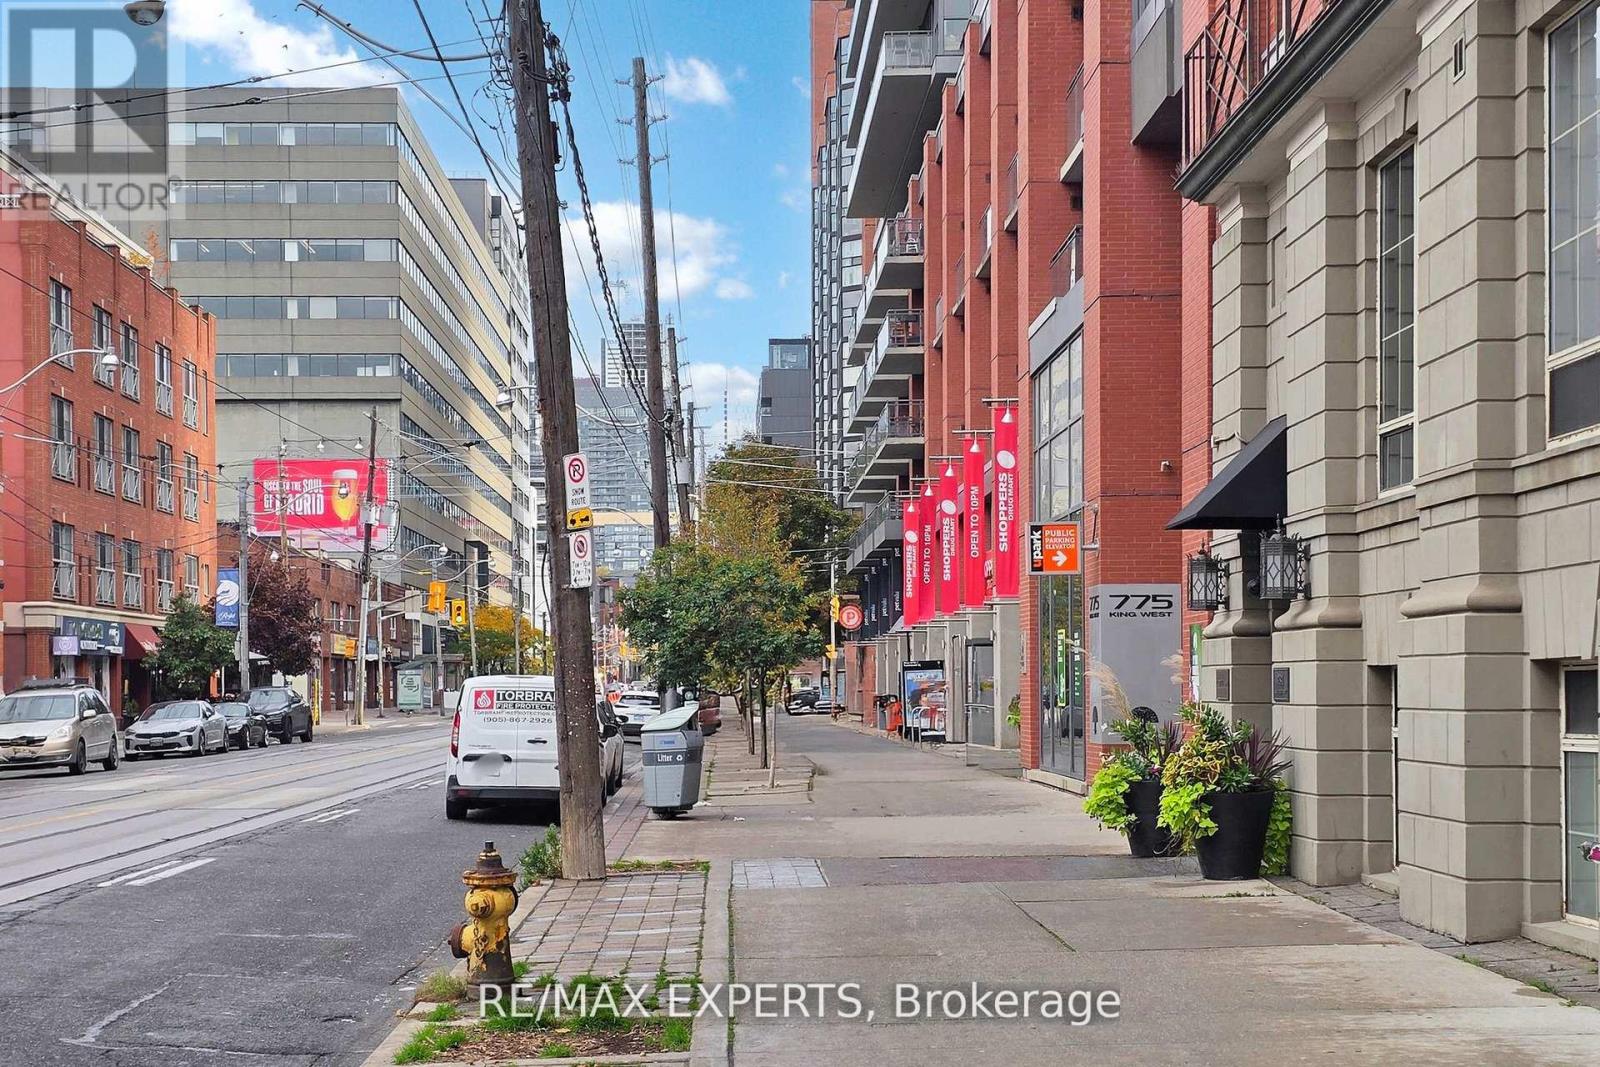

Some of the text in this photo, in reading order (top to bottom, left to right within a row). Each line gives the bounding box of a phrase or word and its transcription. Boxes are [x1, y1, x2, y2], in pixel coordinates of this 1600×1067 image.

[303, 478, 324, 493] SOUL
[571, 487, 585, 496] SNOW
[571, 497, 586, 506] ROUTE
[998, 473, 1008, 552] SHOPPERS
[970, 485, 979, 558] OPEN TO 10PM
[924, 548, 931, 558] TO
[943, 517, 951, 581] SHOPPERS
[1031, 530, 1043, 568] upark
[905, 545, 913, 598] SHOPPERS
[1109, 594, 1173, 609] 775
[497, 690, 556, 702] TORBRA
[657, 754, 673, 762] Litter
